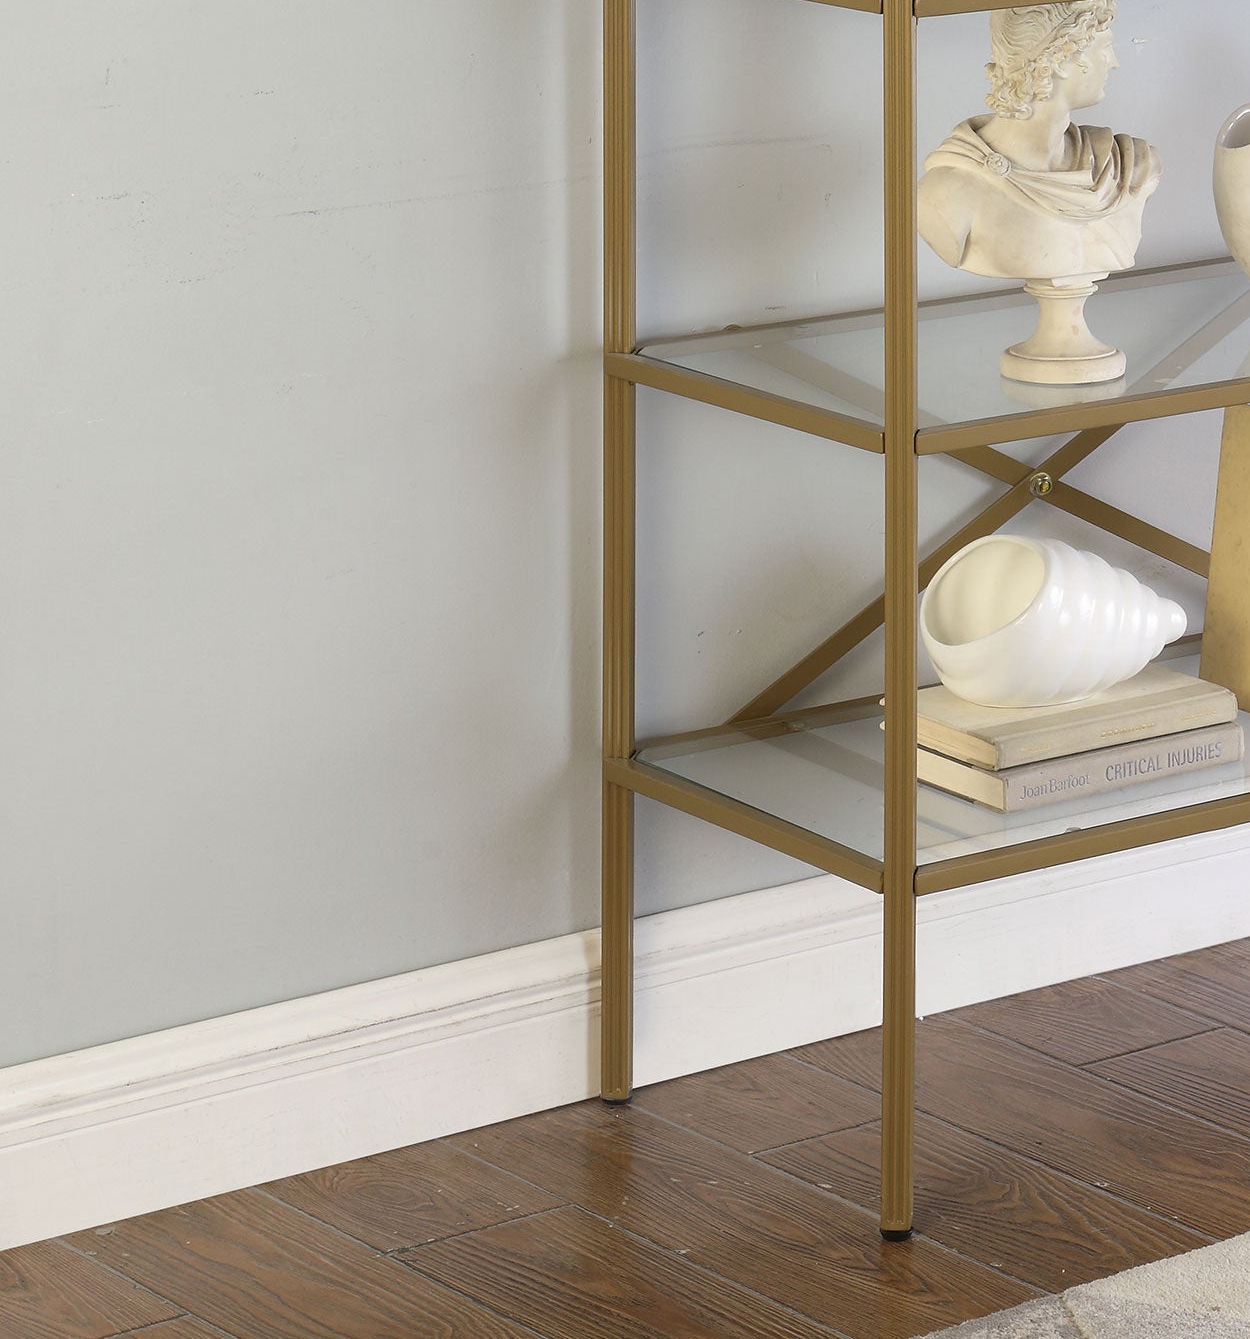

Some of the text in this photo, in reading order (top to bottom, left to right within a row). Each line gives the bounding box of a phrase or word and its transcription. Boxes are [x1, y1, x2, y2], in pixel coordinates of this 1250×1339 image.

[1019, 741, 1222, 800] Joan Barfoot CRITICAL INJURIES
